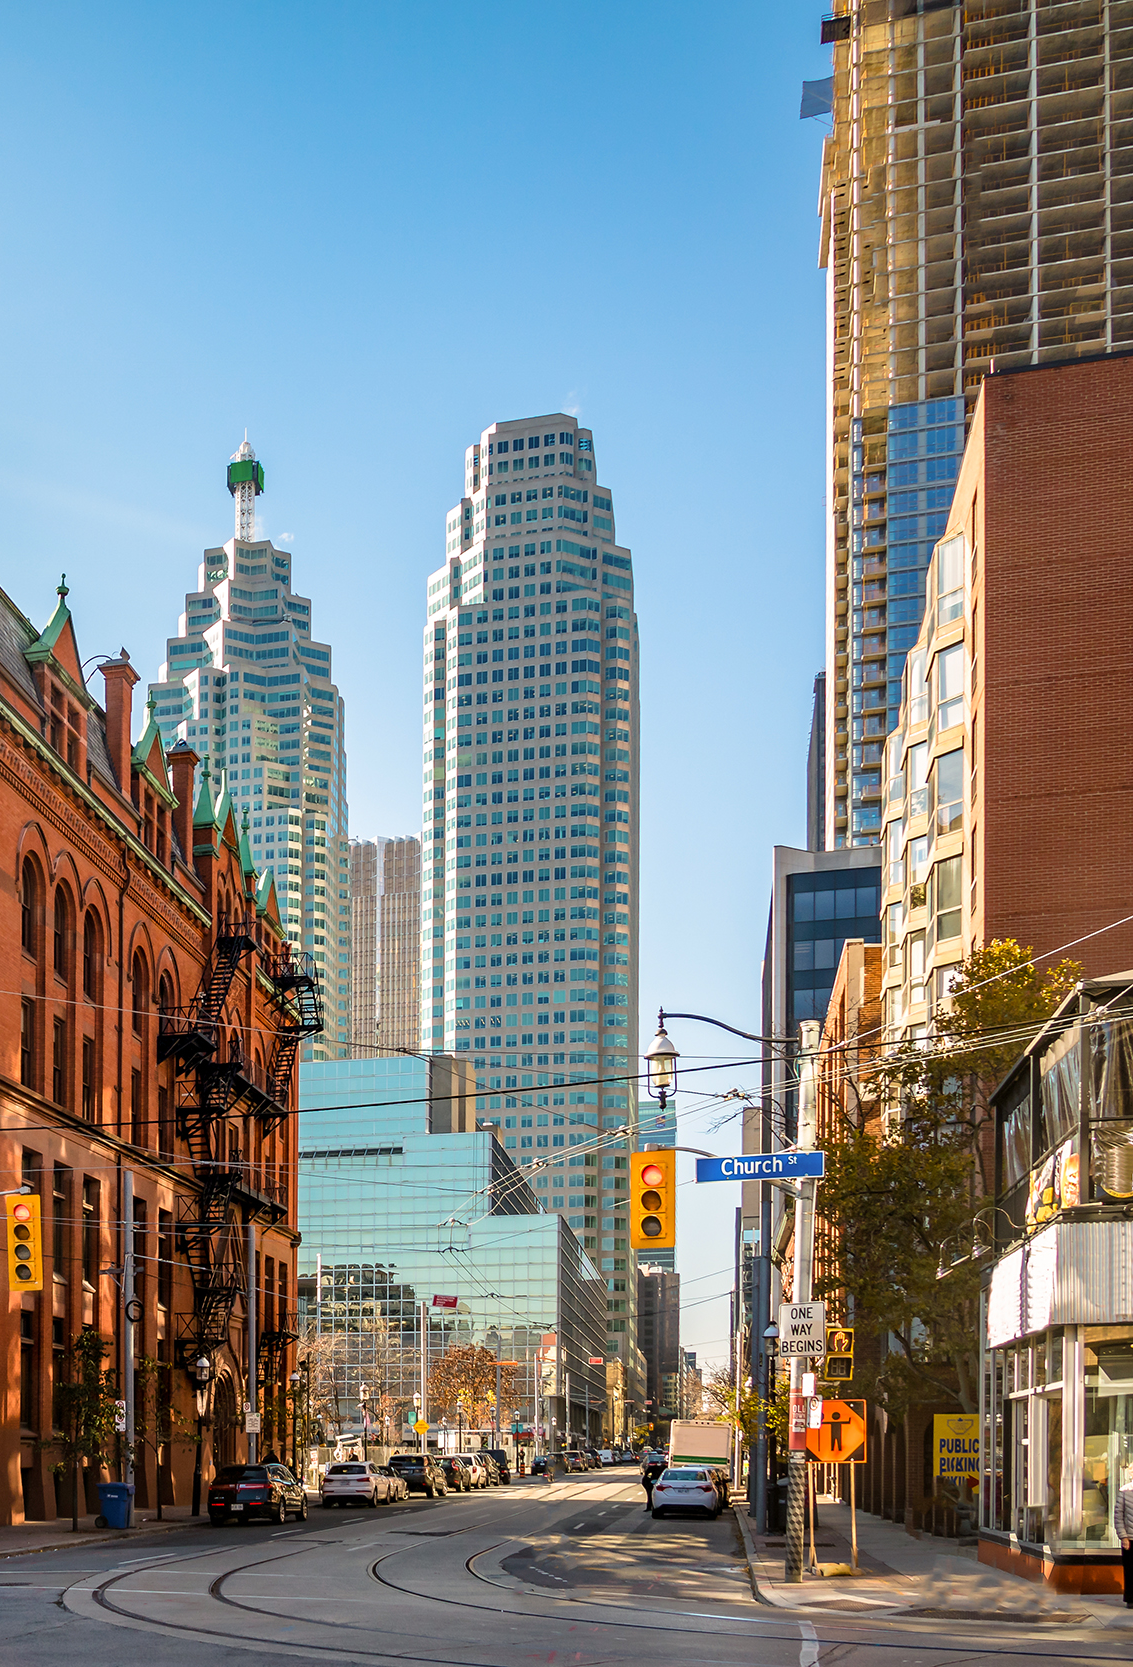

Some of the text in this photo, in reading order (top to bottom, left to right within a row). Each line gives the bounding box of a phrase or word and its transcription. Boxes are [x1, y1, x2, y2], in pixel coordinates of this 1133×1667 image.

[720, 1155, 798, 1176] Church St
[790, 1306, 813, 1319] ONE
[790, 1323, 813, 1336] WAY
[781, 1339, 823, 1353] BEGINS
[939, 1438, 979, 1454] PUBLIC
